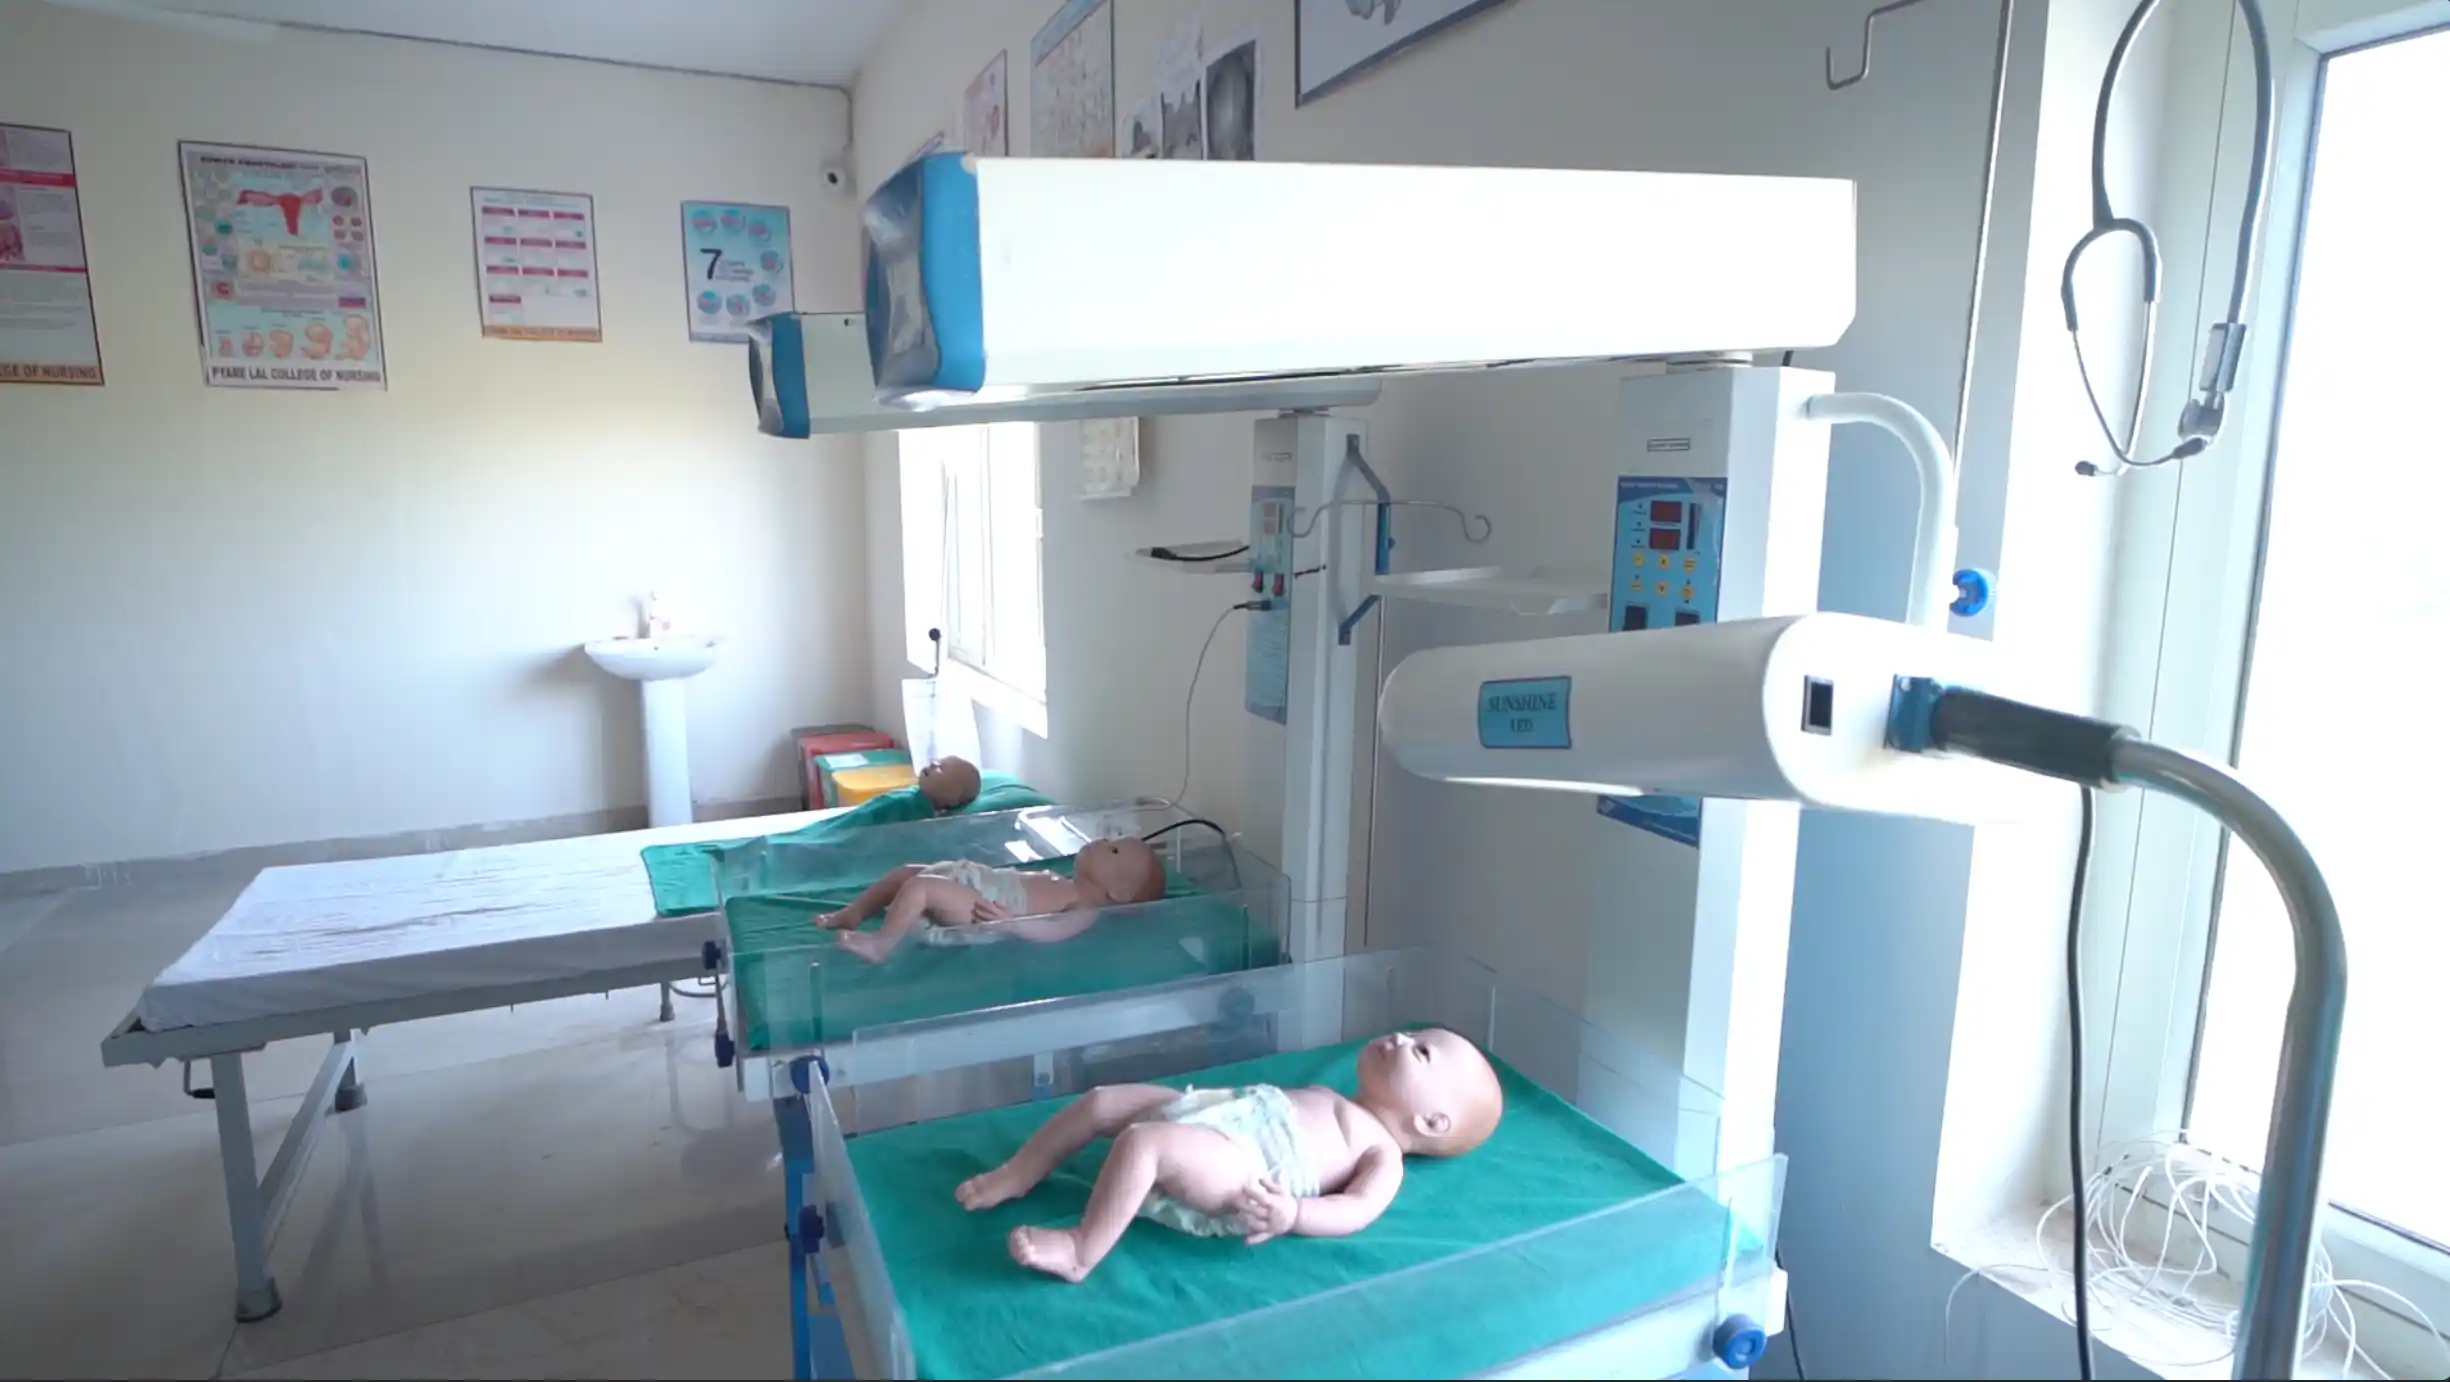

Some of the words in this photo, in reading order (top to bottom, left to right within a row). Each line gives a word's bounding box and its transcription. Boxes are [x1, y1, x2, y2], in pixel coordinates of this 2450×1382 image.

[700, 248, 723, 280] 7
[24, 364, 39, 378] OF
[42, 364, 98, 379] NURSING
[249, 366, 268, 381] LAL
[271, 367, 317, 382] COLLEGE
[319, 369, 333, 382] OF
[336, 370, 381, 383] NURSING
[1487, 692, 1558, 713] SUNSHINE
